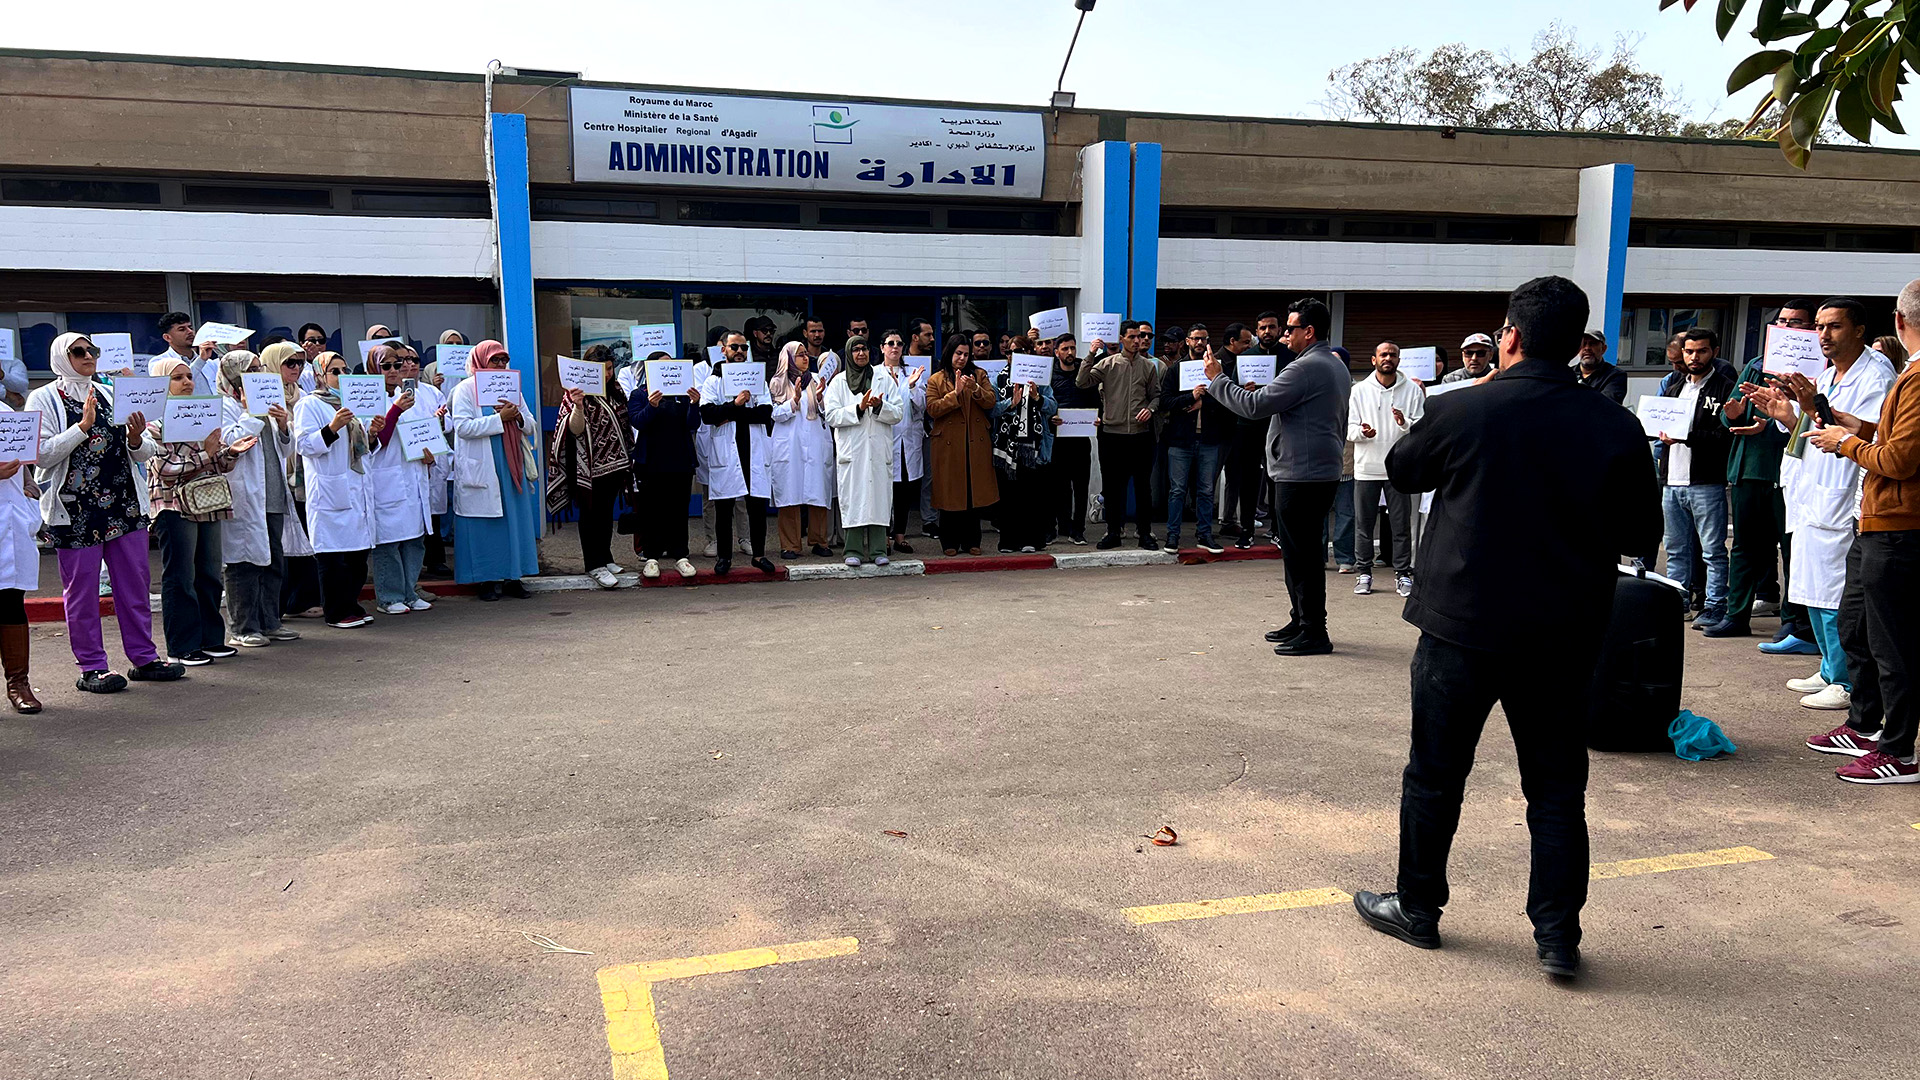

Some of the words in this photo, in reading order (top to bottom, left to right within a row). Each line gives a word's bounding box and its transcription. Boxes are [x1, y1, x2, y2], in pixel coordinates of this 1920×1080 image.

[629, 96, 671, 107] Royaume
[673, 98, 684, 107] du
[685, 99, 713, 108] Maroc
[624, 109, 667, 120] Ministère
[669, 112, 680, 121] de
[682, 113, 691, 121] la
[693, 113, 719, 123] Santé
[940, 117, 975, 126] المغربية
[975, 118, 1002, 126] المملكة
[583, 122, 615, 132] Centre
[617, 123, 667, 135] Hospitalier
[676, 127, 711, 138] Regional
[721, 128, 758, 139] d'Agadir
[949, 128, 976, 136] الصحة
[977, 130, 995, 138] وزارة
[947, 141, 970, 149] الجهوي
[608, 141, 829, 179] ADMINISTRATION
[1703, 396, 1721, 416] NY
